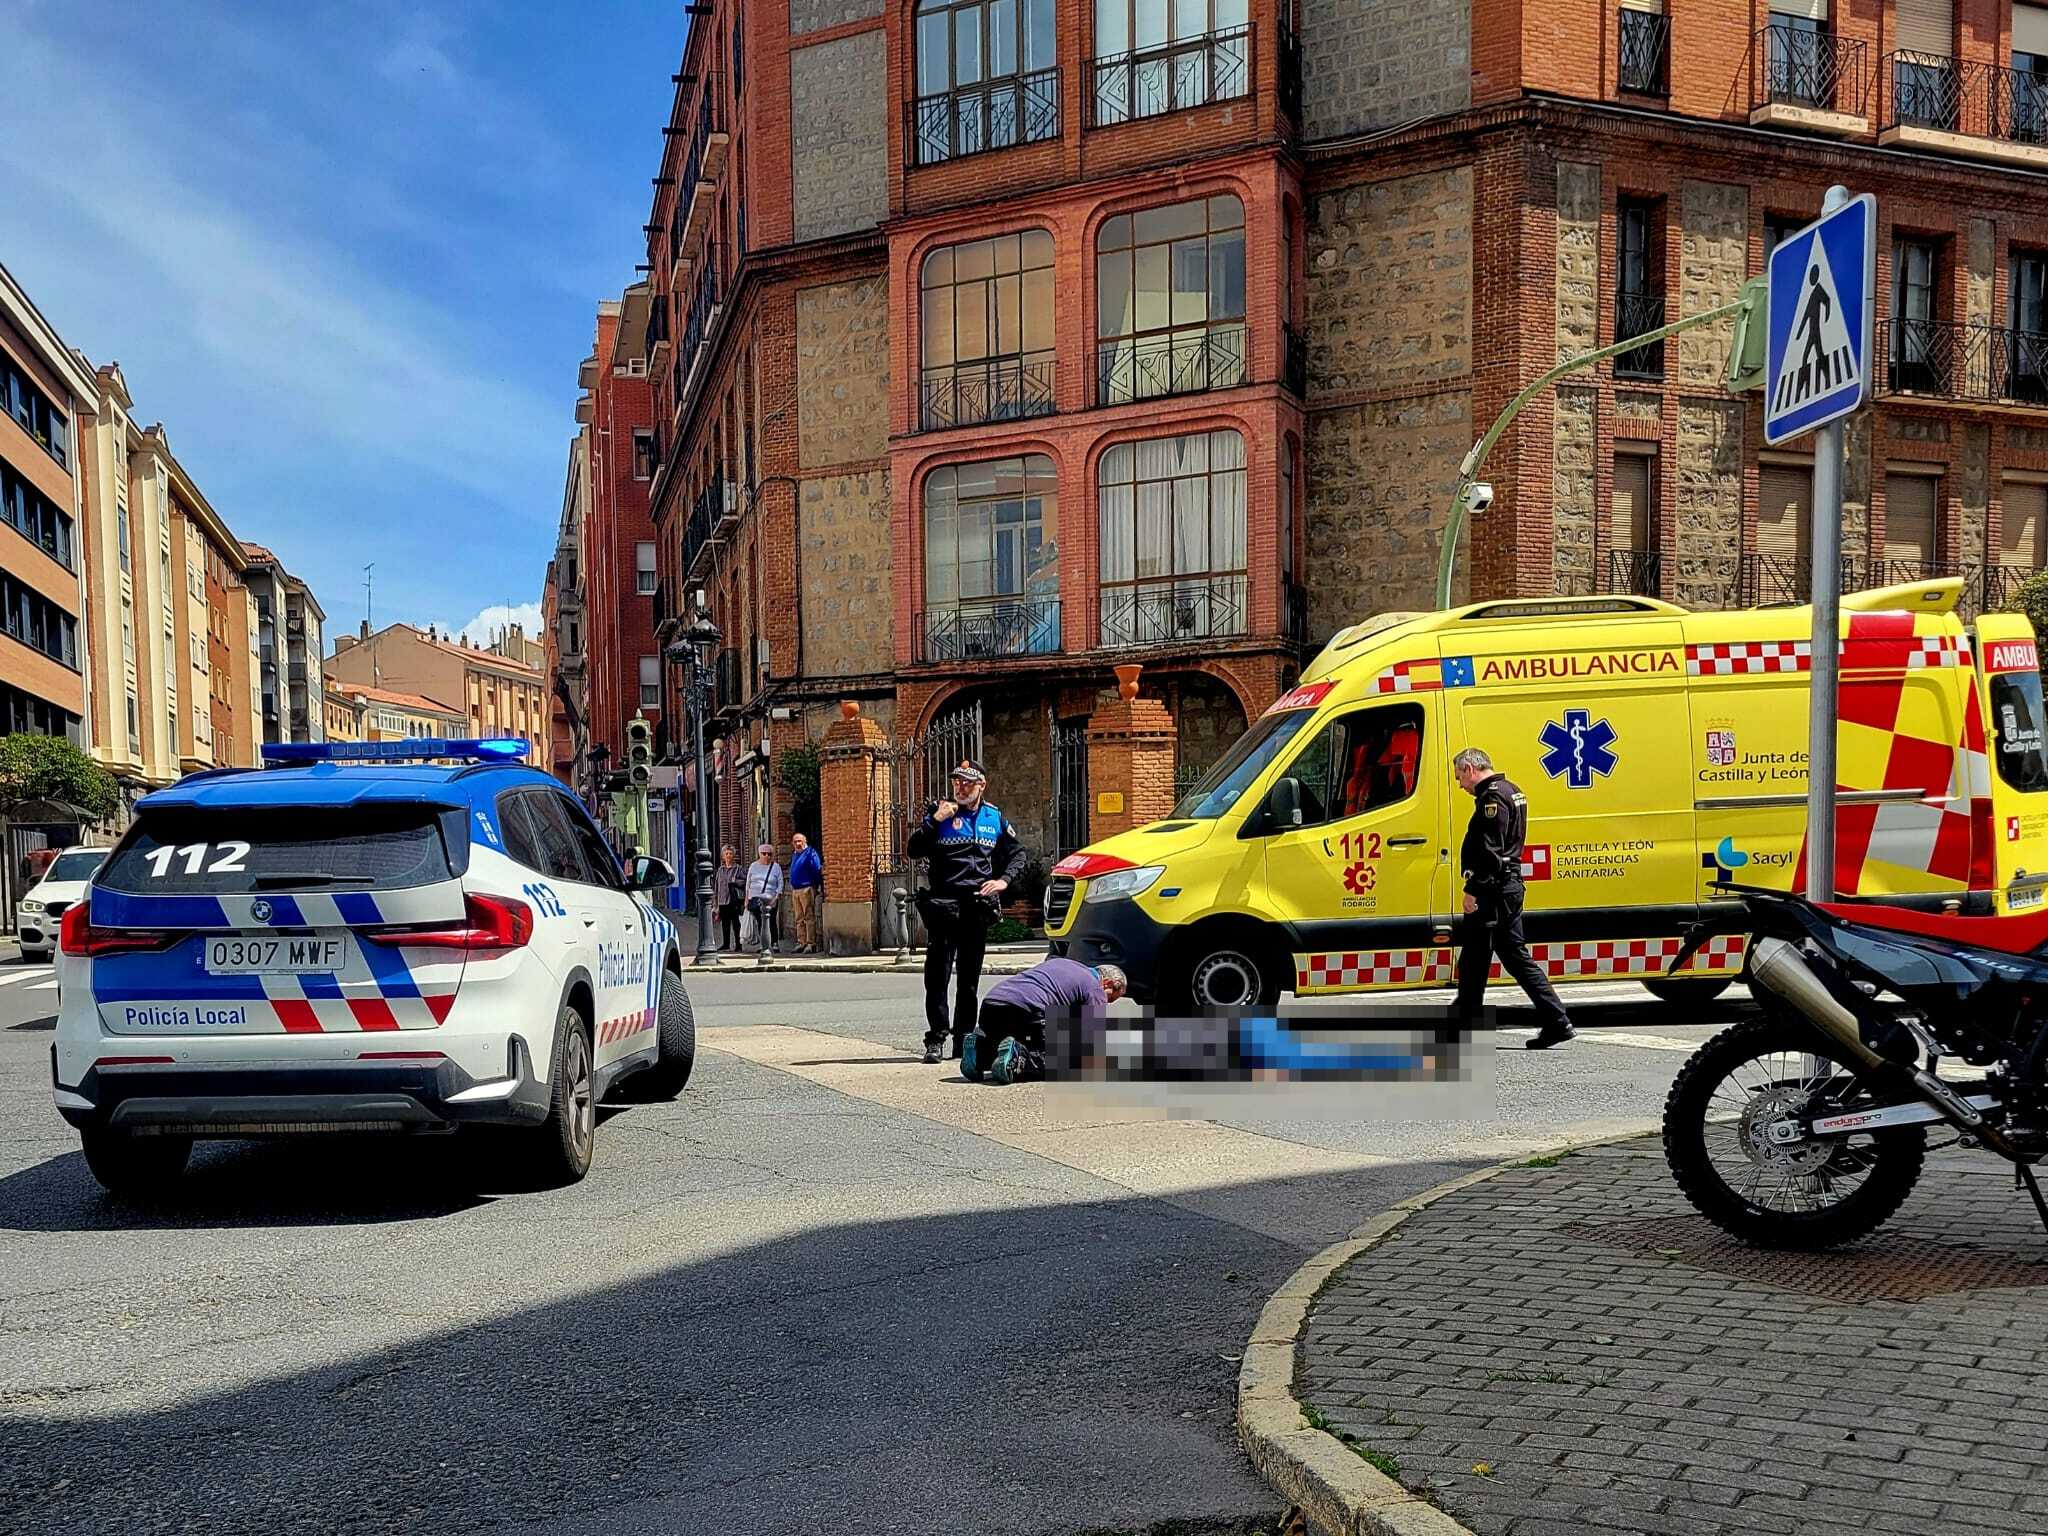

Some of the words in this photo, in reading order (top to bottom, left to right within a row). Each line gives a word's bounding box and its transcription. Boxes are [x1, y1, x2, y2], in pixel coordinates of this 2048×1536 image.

[1481, 652, 1680, 681] AMBULANCIA
[1742, 751, 1785, 765] Junta
[1790, 750, 1809, 763] de
[1699, 768, 1753, 782] Castilla
[1757, 769, 1767, 784] y
[1772, 766, 1809, 780] León
[1340, 832, 1382, 860] 112
[1556, 842, 1610, 854] CASTILLA
[1612, 841, 1620, 852] Y
[1622, 839, 1654, 851] LEÓN
[144, 841, 251, 877] 112
[1557, 854, 1640, 867] EMERGENCIAS
[1752, 851, 1793, 868] Sacyl
[1556, 867, 1625, 880] SANITARIAS
[522, 883, 568, 918] 112
[212, 942, 280, 967] 0307
[288, 941, 339, 966] MWF
[599, 940, 625, 990] Policía
[626, 942, 646, 986] Local
[125, 1007, 190, 1026] Policía
[195, 1006, 247, 1026] Local
